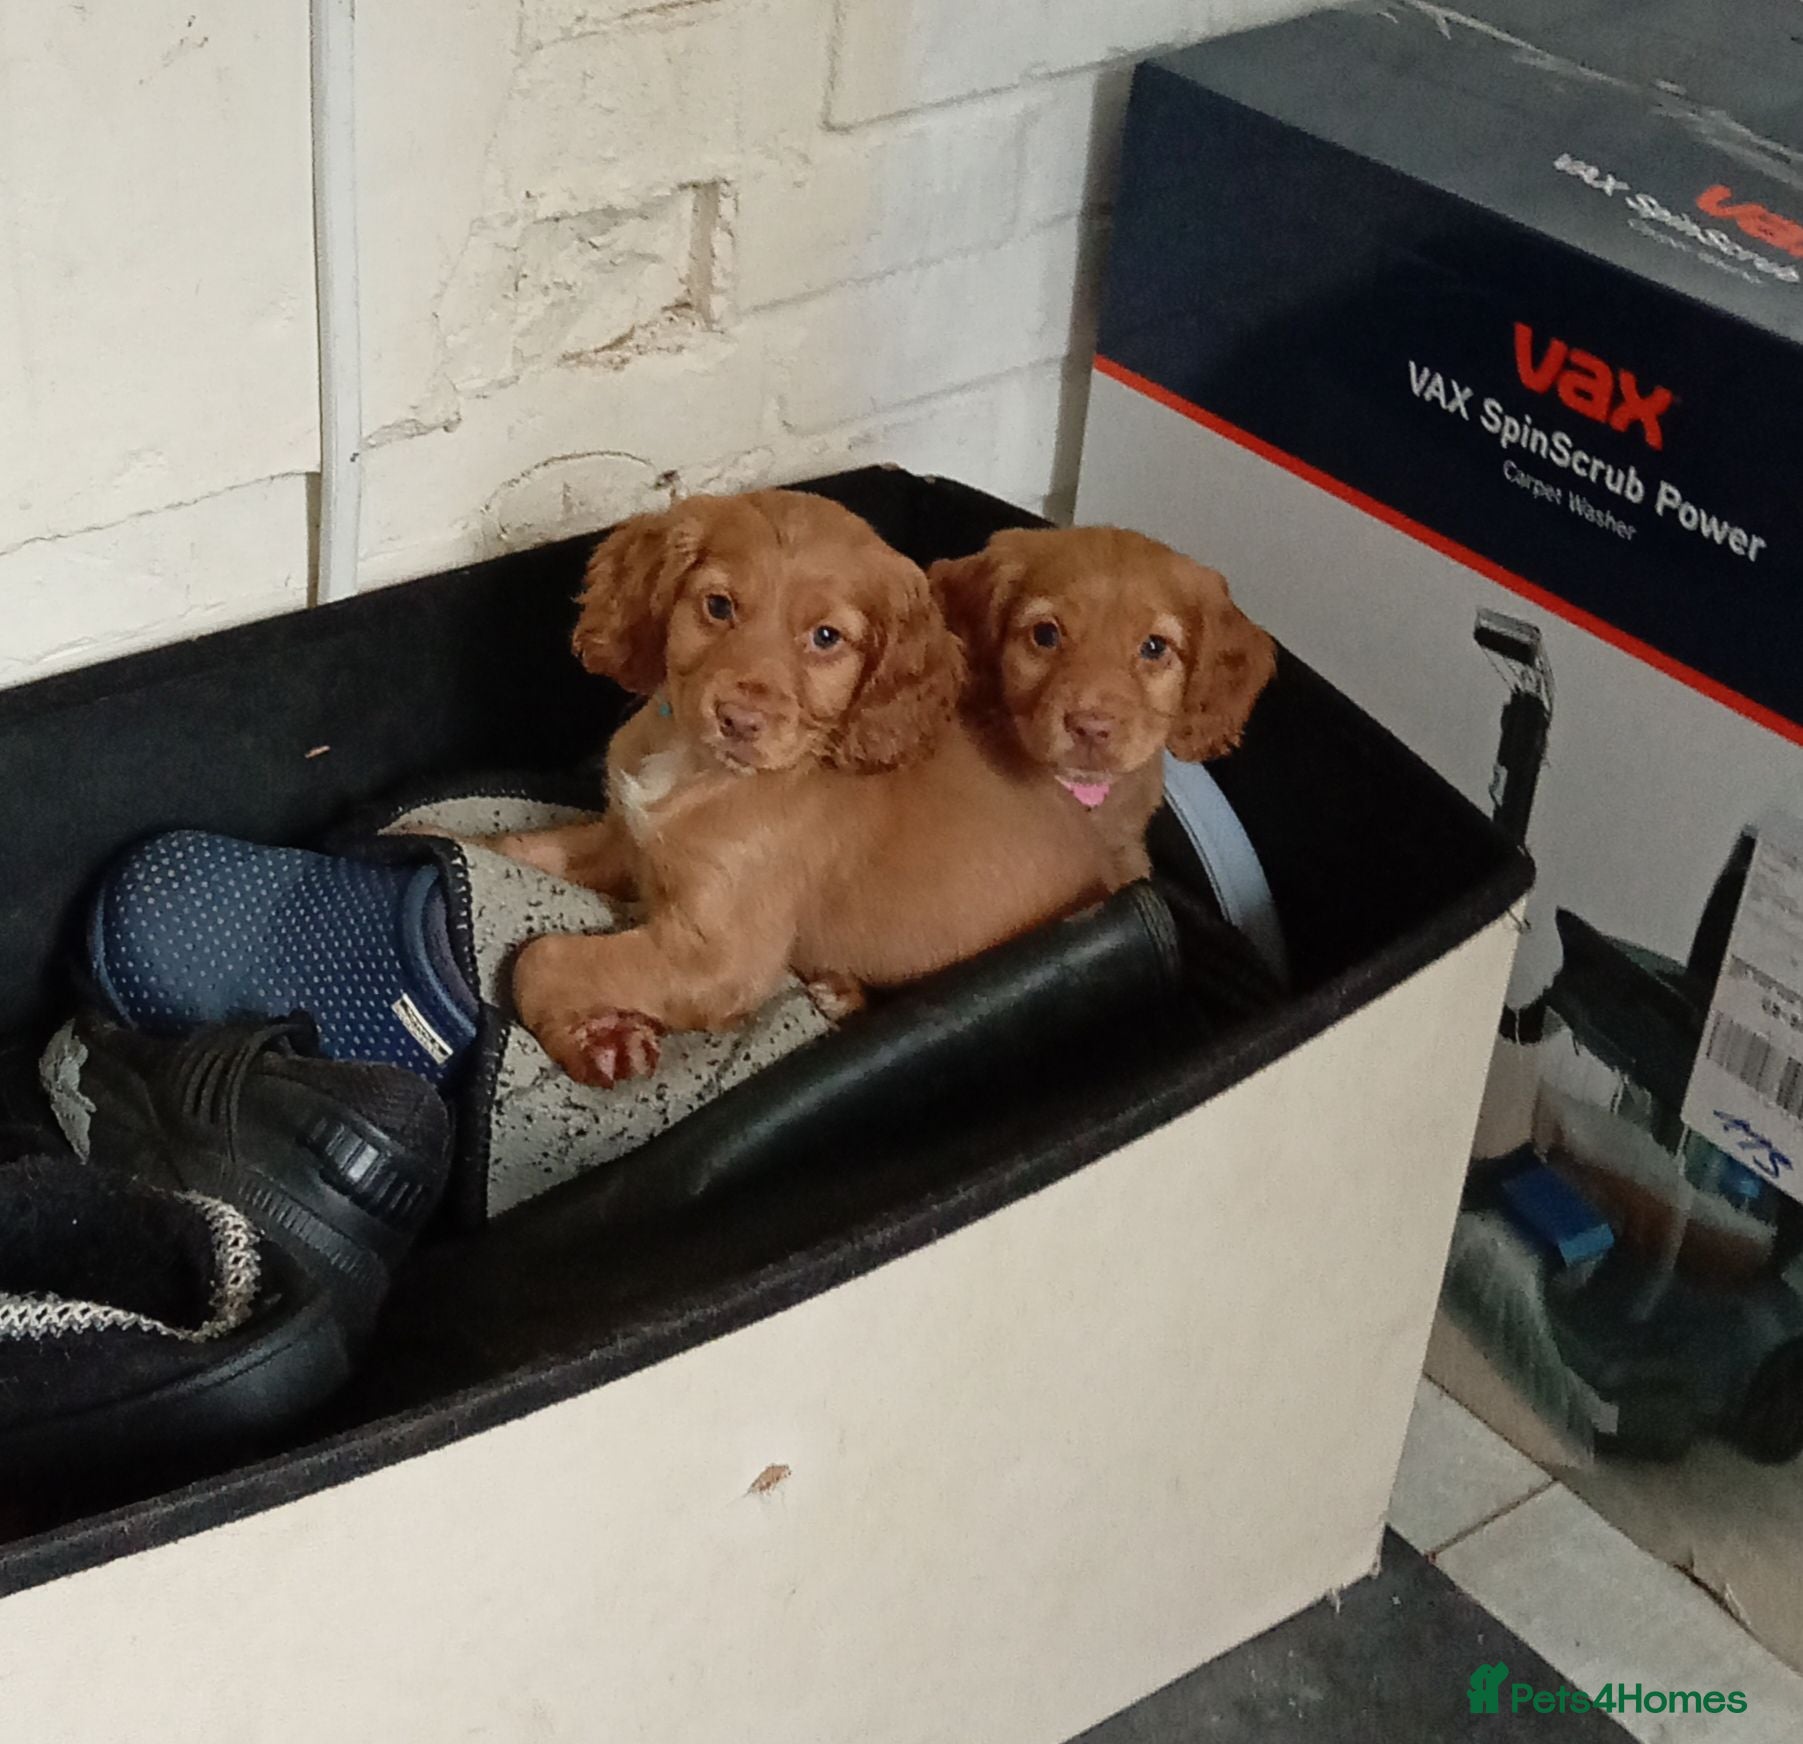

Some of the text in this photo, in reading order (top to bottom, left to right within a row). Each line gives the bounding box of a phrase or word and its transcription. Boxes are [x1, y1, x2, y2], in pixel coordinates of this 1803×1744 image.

[1514, 321, 1673, 450] vax
[1408, 359, 1768, 562] VAX SpinScrub Power
[1502, 459, 1638, 542] Carpet Washer
